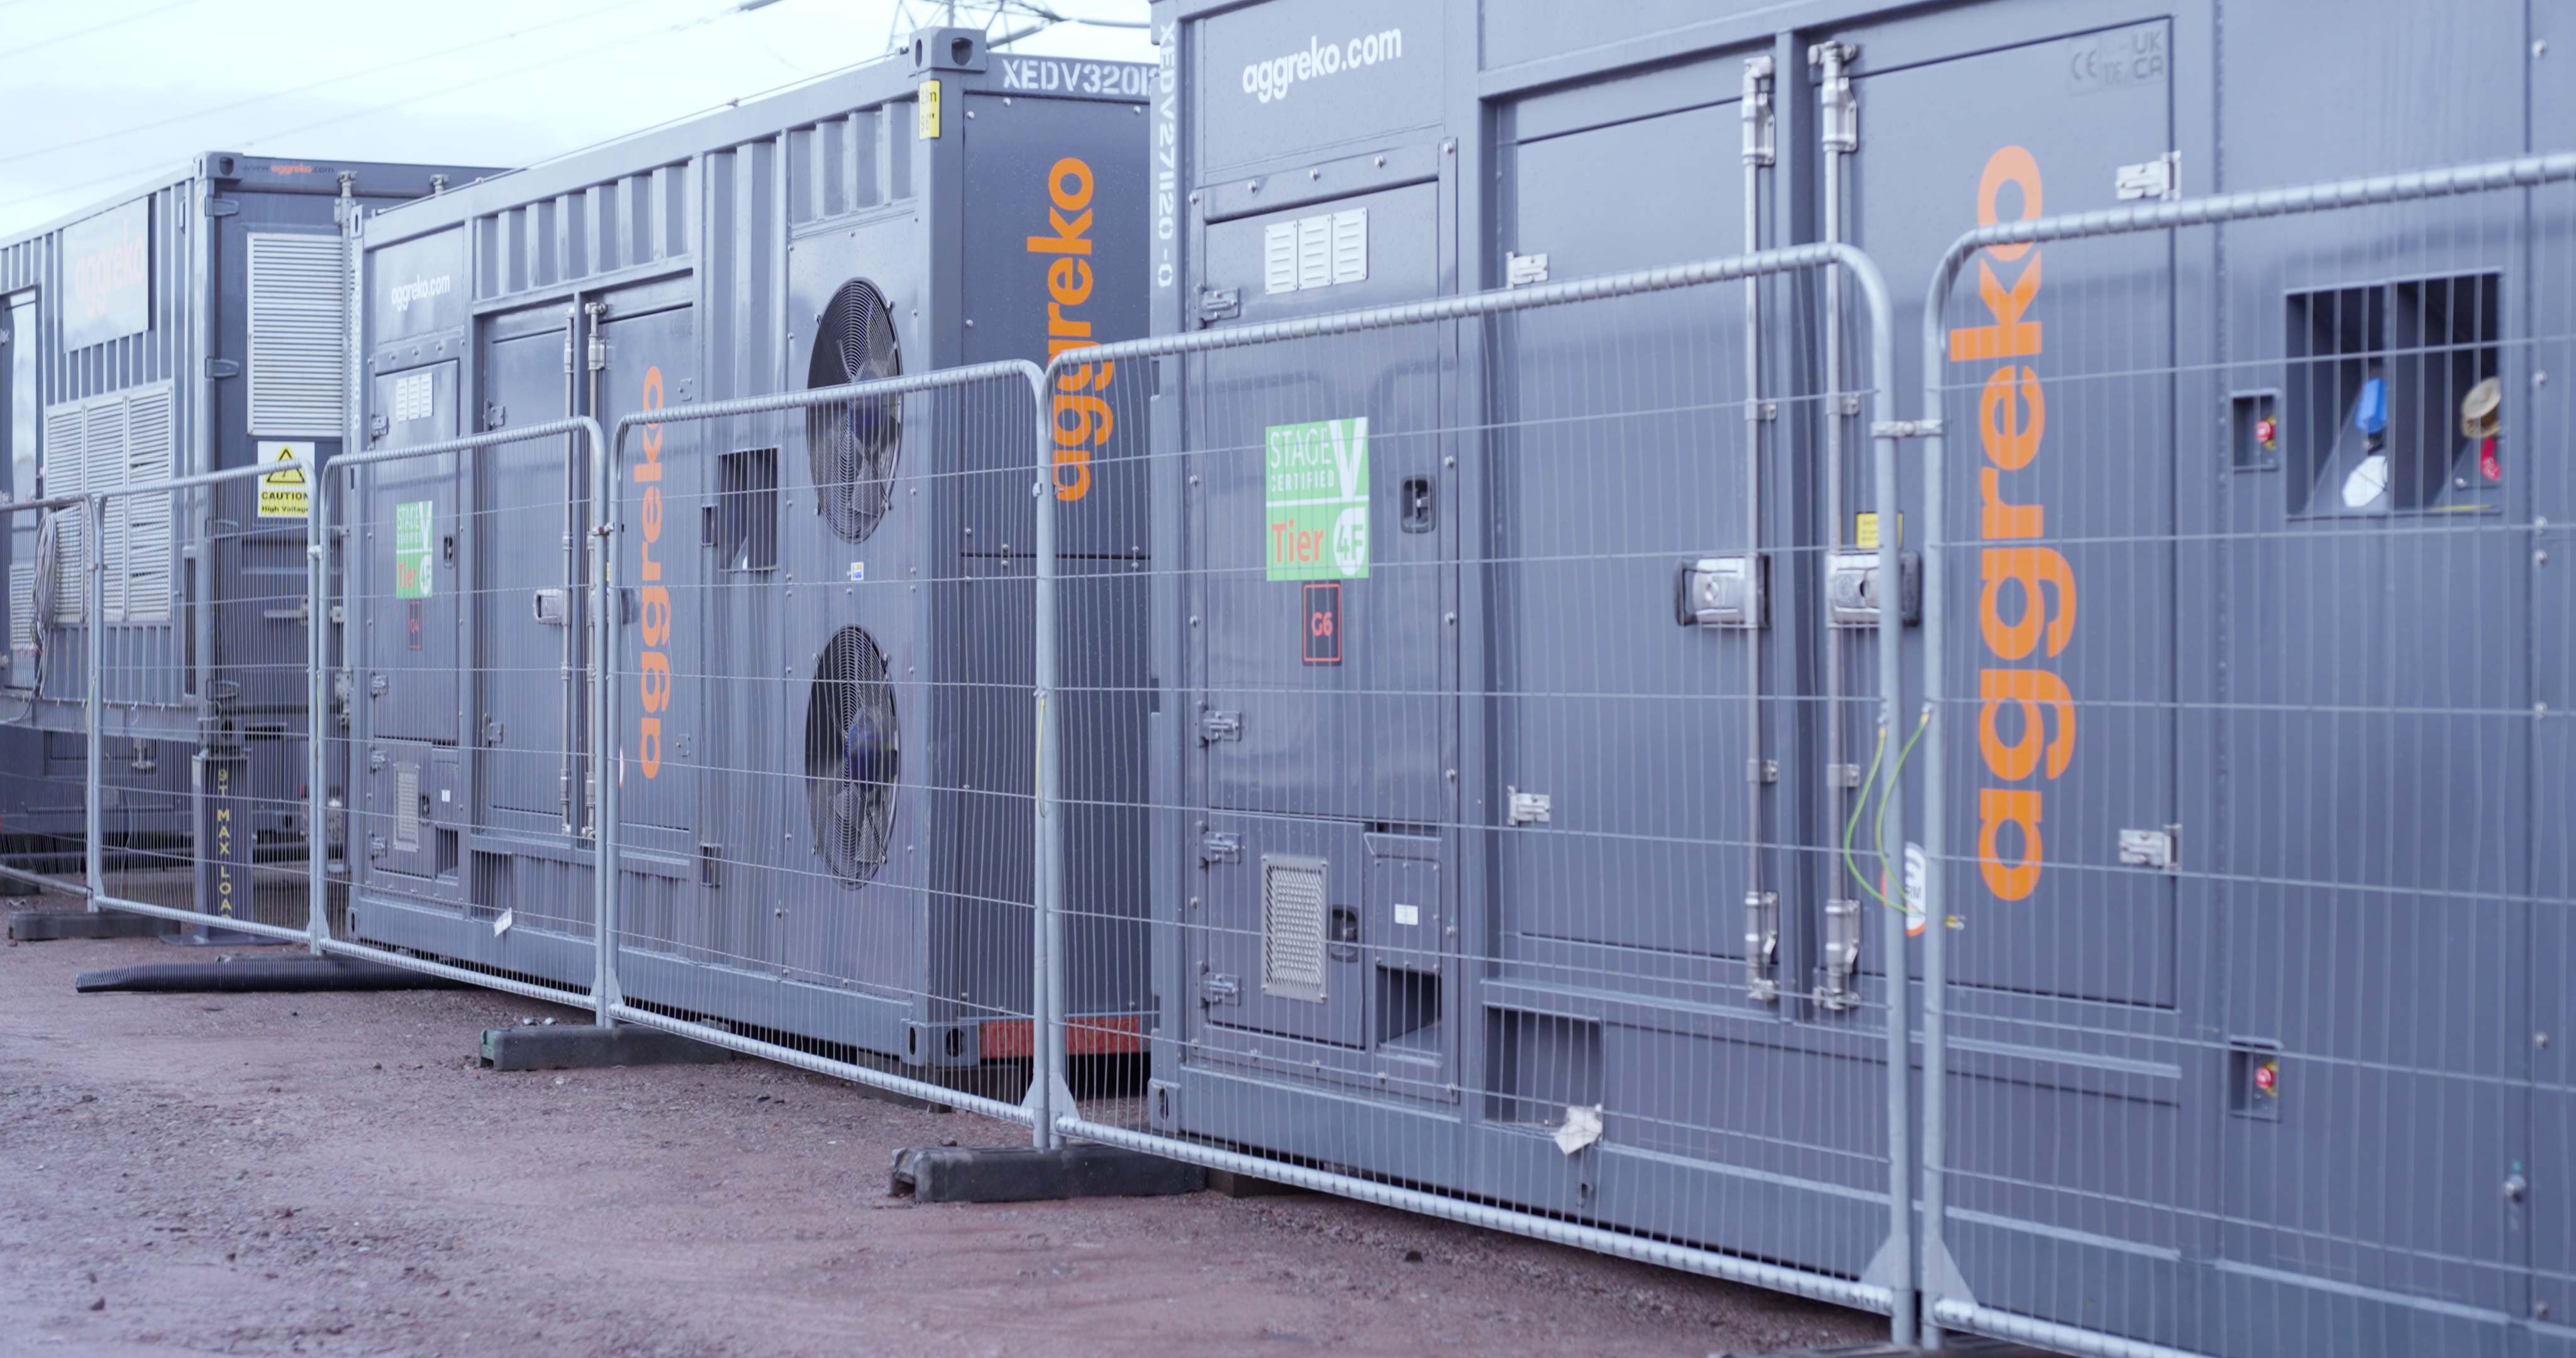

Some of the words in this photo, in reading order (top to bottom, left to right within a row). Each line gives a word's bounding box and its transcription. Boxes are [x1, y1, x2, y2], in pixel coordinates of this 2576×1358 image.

[2133, 30, 2163, 53] UK
[1242, 28, 1402, 103] aggreko.com
[2072, 50, 2097, 80] CE
[2133, 55, 2163, 79] CA
[243, 163, 334, 175] www.aggreko.com
[75, 220, 145, 319] aggreko
[391, 273, 450, 312] aggreko.com
[1027, 157, 1113, 502] aggreko
[1270, 428, 1332, 468] STAGE
[1328, 416, 1368, 500] V
[262, 492, 308, 500] CAUTION
[1271, 469, 1335, 492] CERTIFIED
[1271, 518, 1324, 563] Tier
[1336, 524, 1364, 561] 4F
[1950, 145, 2076, 900] aggreko
[398, 561, 417, 588] Tier
[634, 366, 670, 780] aggreko
[1311, 612, 1333, 636] G6
[219, 769, 228, 797] 9T
[218, 809, 230, 855] MAX
[219, 865, 232, 919] LOA
